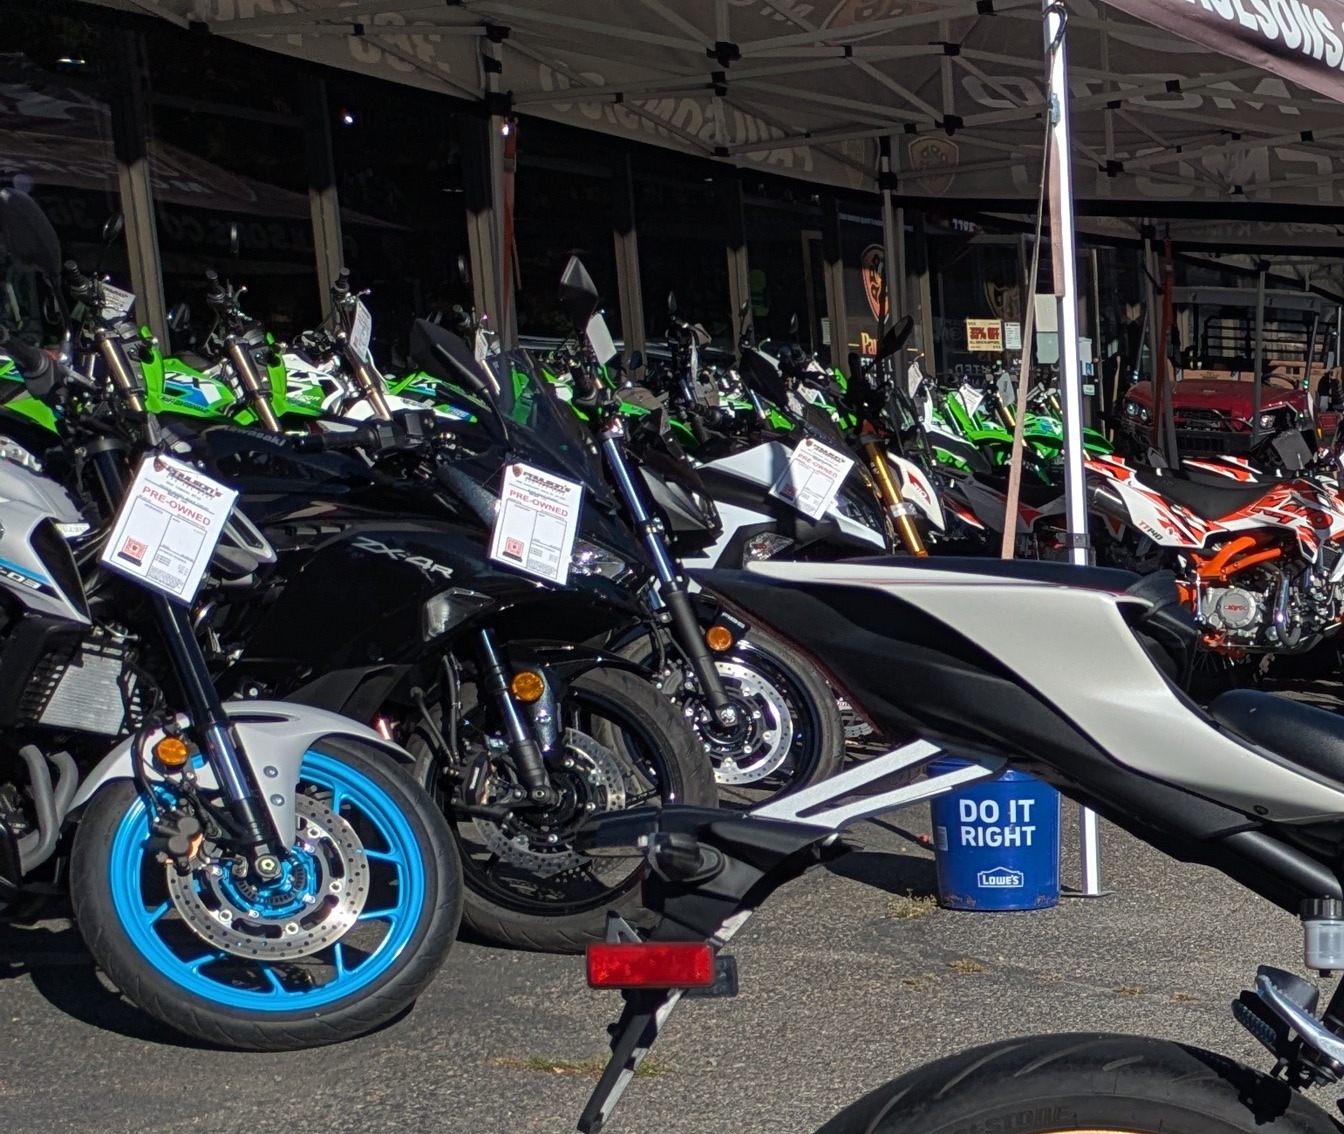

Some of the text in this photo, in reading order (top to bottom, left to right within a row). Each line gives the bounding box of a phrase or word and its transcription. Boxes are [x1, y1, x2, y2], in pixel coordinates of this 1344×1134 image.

[797, 453, 838, 478] PRE-OWNED
[142, 485, 211, 526] PRE-OWNED
[509, 489, 569, 517] PRE-OWNED
[351, 535, 454, 580] ZX-4R
[959, 799, 1035, 823] DO IT
[960, 825, 1036, 847] RIGHT
